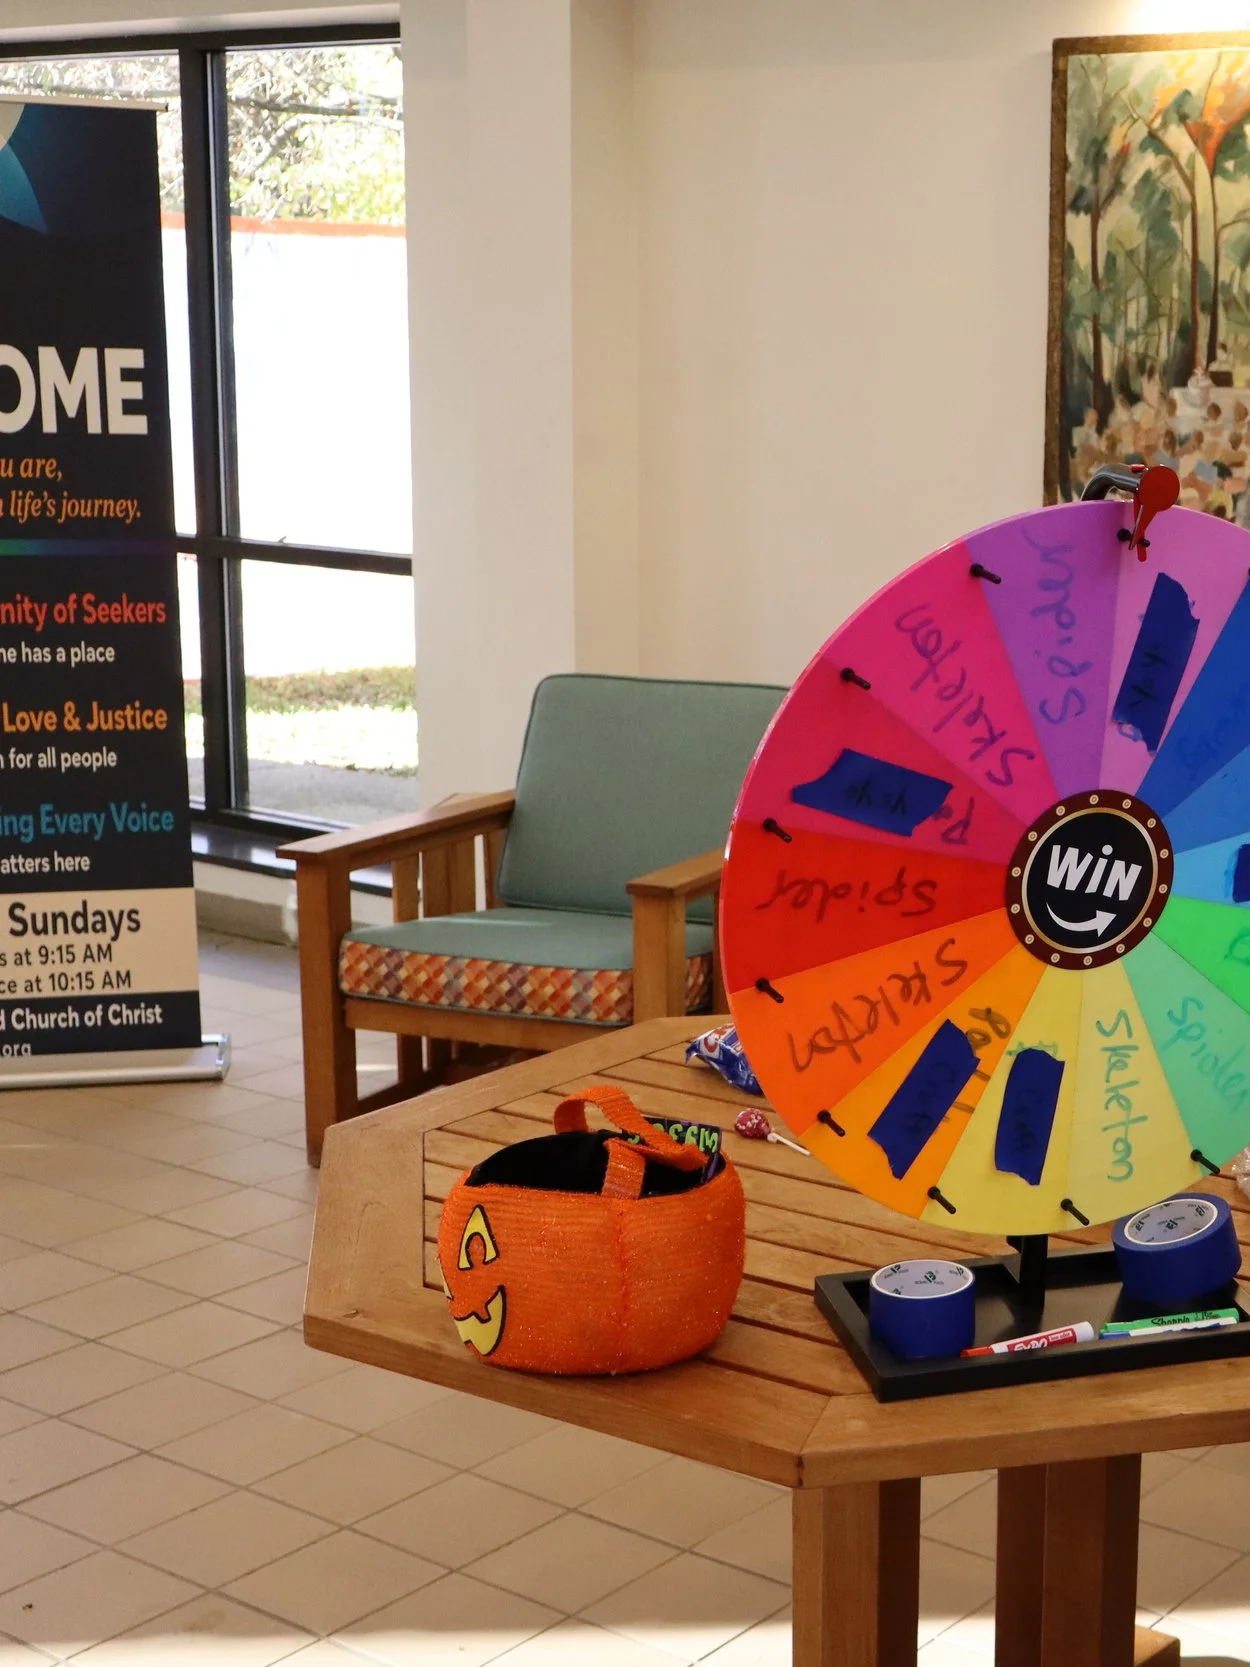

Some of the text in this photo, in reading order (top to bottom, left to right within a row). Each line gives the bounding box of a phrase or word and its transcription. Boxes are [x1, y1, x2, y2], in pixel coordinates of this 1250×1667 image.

[20, 457, 62, 482] are,
[58, 490, 141, 524] journey.
[53, 593, 77, 624] of
[82, 593, 167, 624] Seekers
[21, 641, 51, 663] has
[56, 646, 66, 663] a
[70, 640, 115, 668] place
[2, 700, 168, 733] Love & Justice
[9, 747, 33, 769] for
[37, 746, 57, 768] all
[61, 746, 118, 773] people
[40, 803, 105, 841] Every
[109, 801, 174, 833] Voice
[54, 850, 90, 873] here
[755, 867, 938, 923] Spider
[8, 900, 141, 942] Sundays
[14, 947, 32, 967] at
[38, 944, 76, 966] 9:15
[83, 943, 113, 964] AM
[24, 975, 42, 993] at
[49, 970, 95, 992] 10:15
[102, 969, 132, 989] AM
[11, 1005, 80, 1030] Church
[84, 1004, 103, 1027] of
[108, 1002, 163, 1026] Christ
